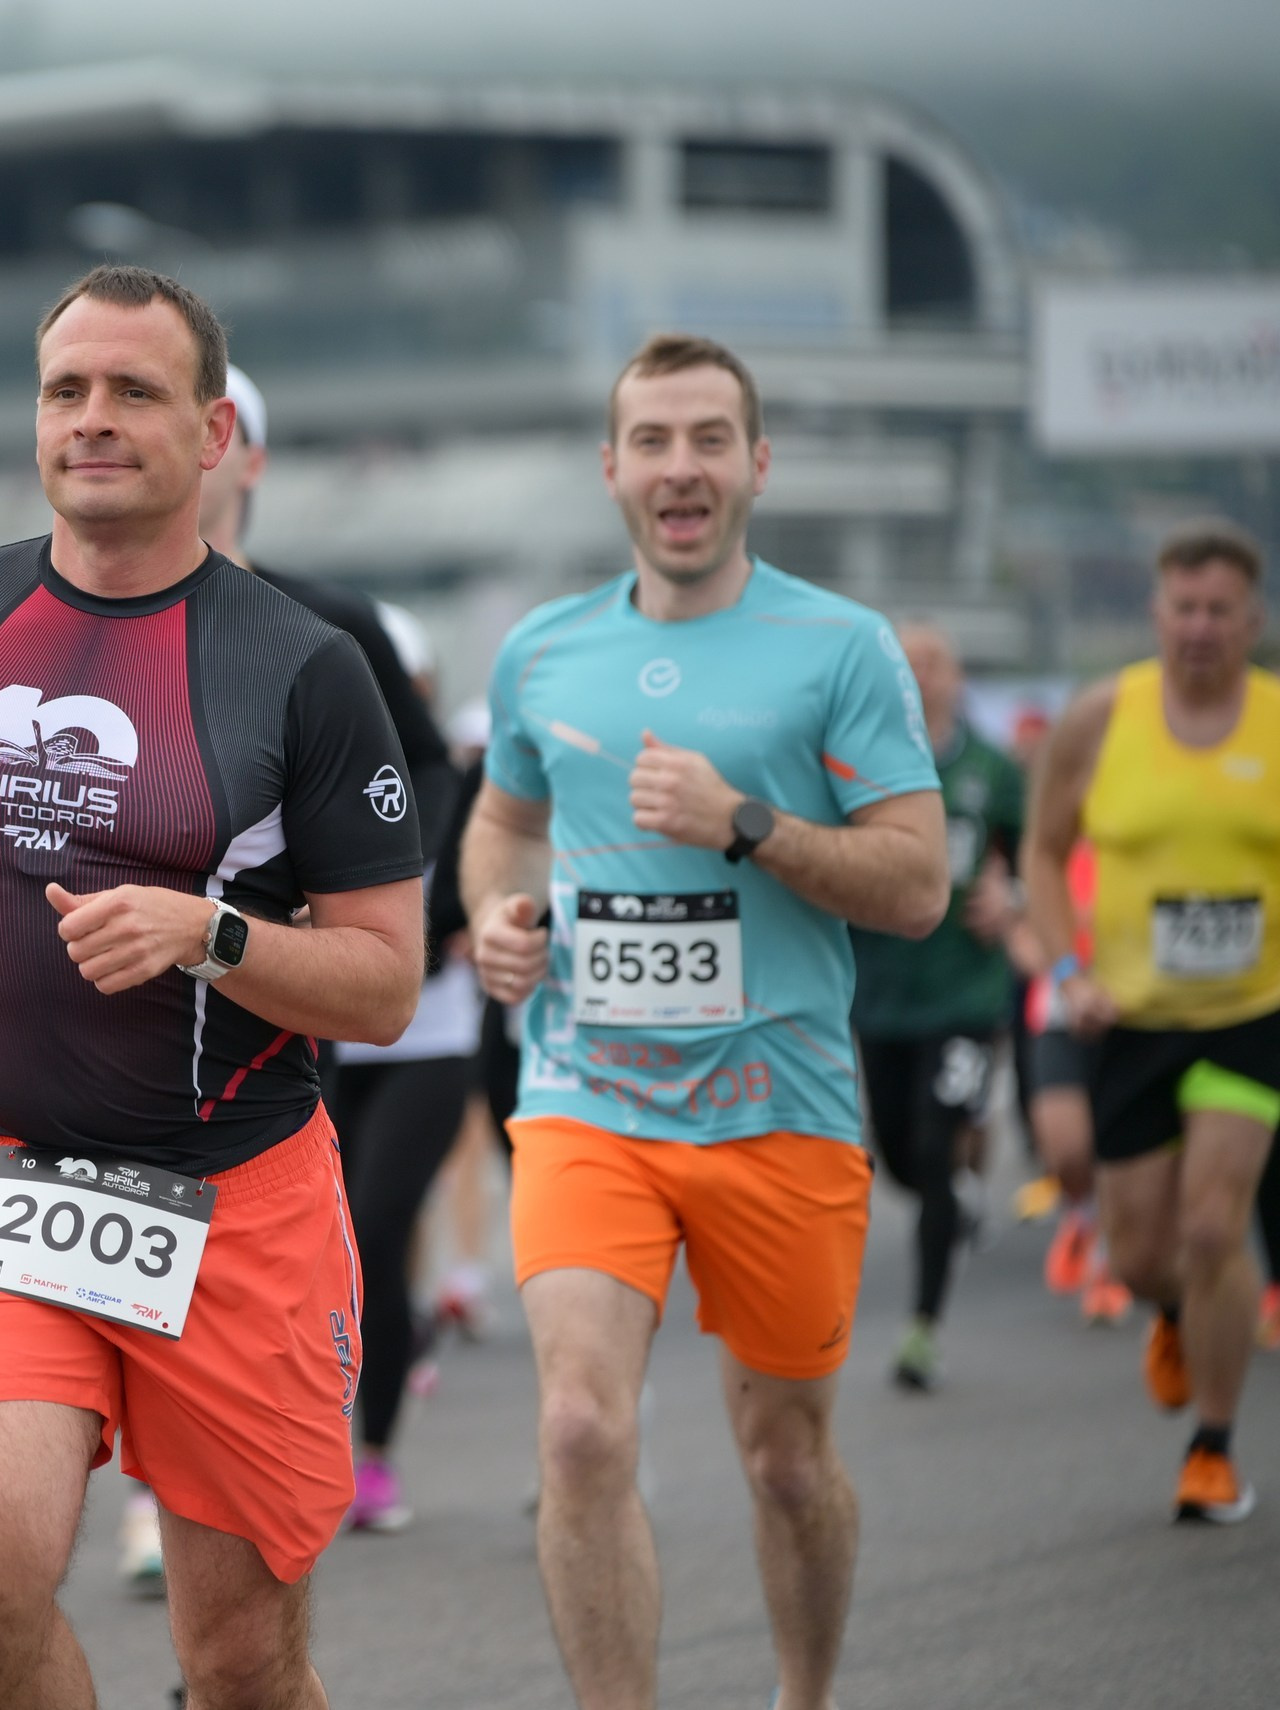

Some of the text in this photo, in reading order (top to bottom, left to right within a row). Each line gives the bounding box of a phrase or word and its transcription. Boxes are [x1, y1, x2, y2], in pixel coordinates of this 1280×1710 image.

[0, 824, 71, 851] RAY
[589, 940, 721, 984] 6533
[587, 1038, 682, 1069] 2023
[21, 1158, 37, 1170] 10
[117, 1166, 140, 1178] RAY
[102, 1180, 149, 1198] AUTODROM
[103, 1172, 151, 1191] SIRIUS
[33, 1277, 68, 1293] МАГНИТ
[86, 1296, 106, 1306] ЛИГА
[88, 1290, 122, 1305] ВЫСШАЯ
[130, 1303, 163, 1321] RAY
